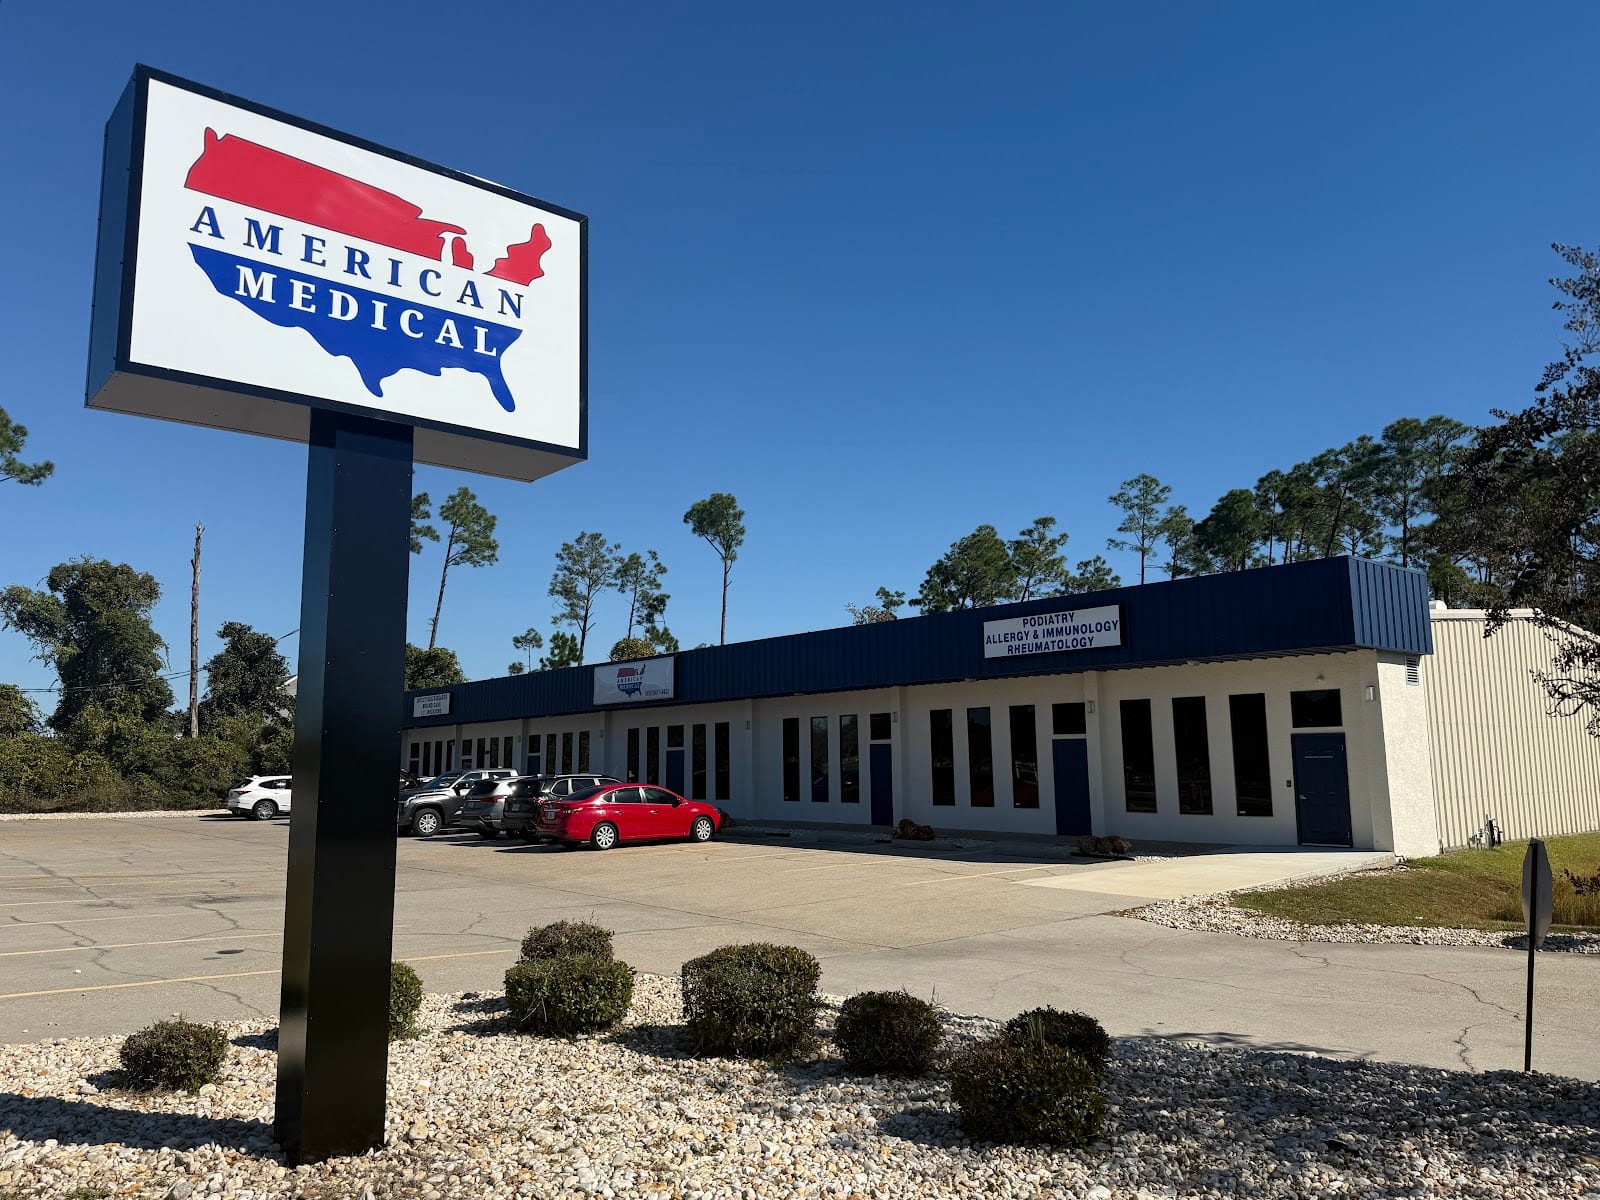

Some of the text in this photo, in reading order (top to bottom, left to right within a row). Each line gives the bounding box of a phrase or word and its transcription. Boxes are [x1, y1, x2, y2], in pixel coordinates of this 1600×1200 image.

[190, 206, 524, 319] AMERICAN
[235, 264, 497, 357] MEDICAL
[985, 620, 1119, 645] ALLERGY & IMMUNOLOGY
[1022, 612, 1075, 628] PODIATRY
[1007, 636, 1095, 655] RHEUMATOLOGY
